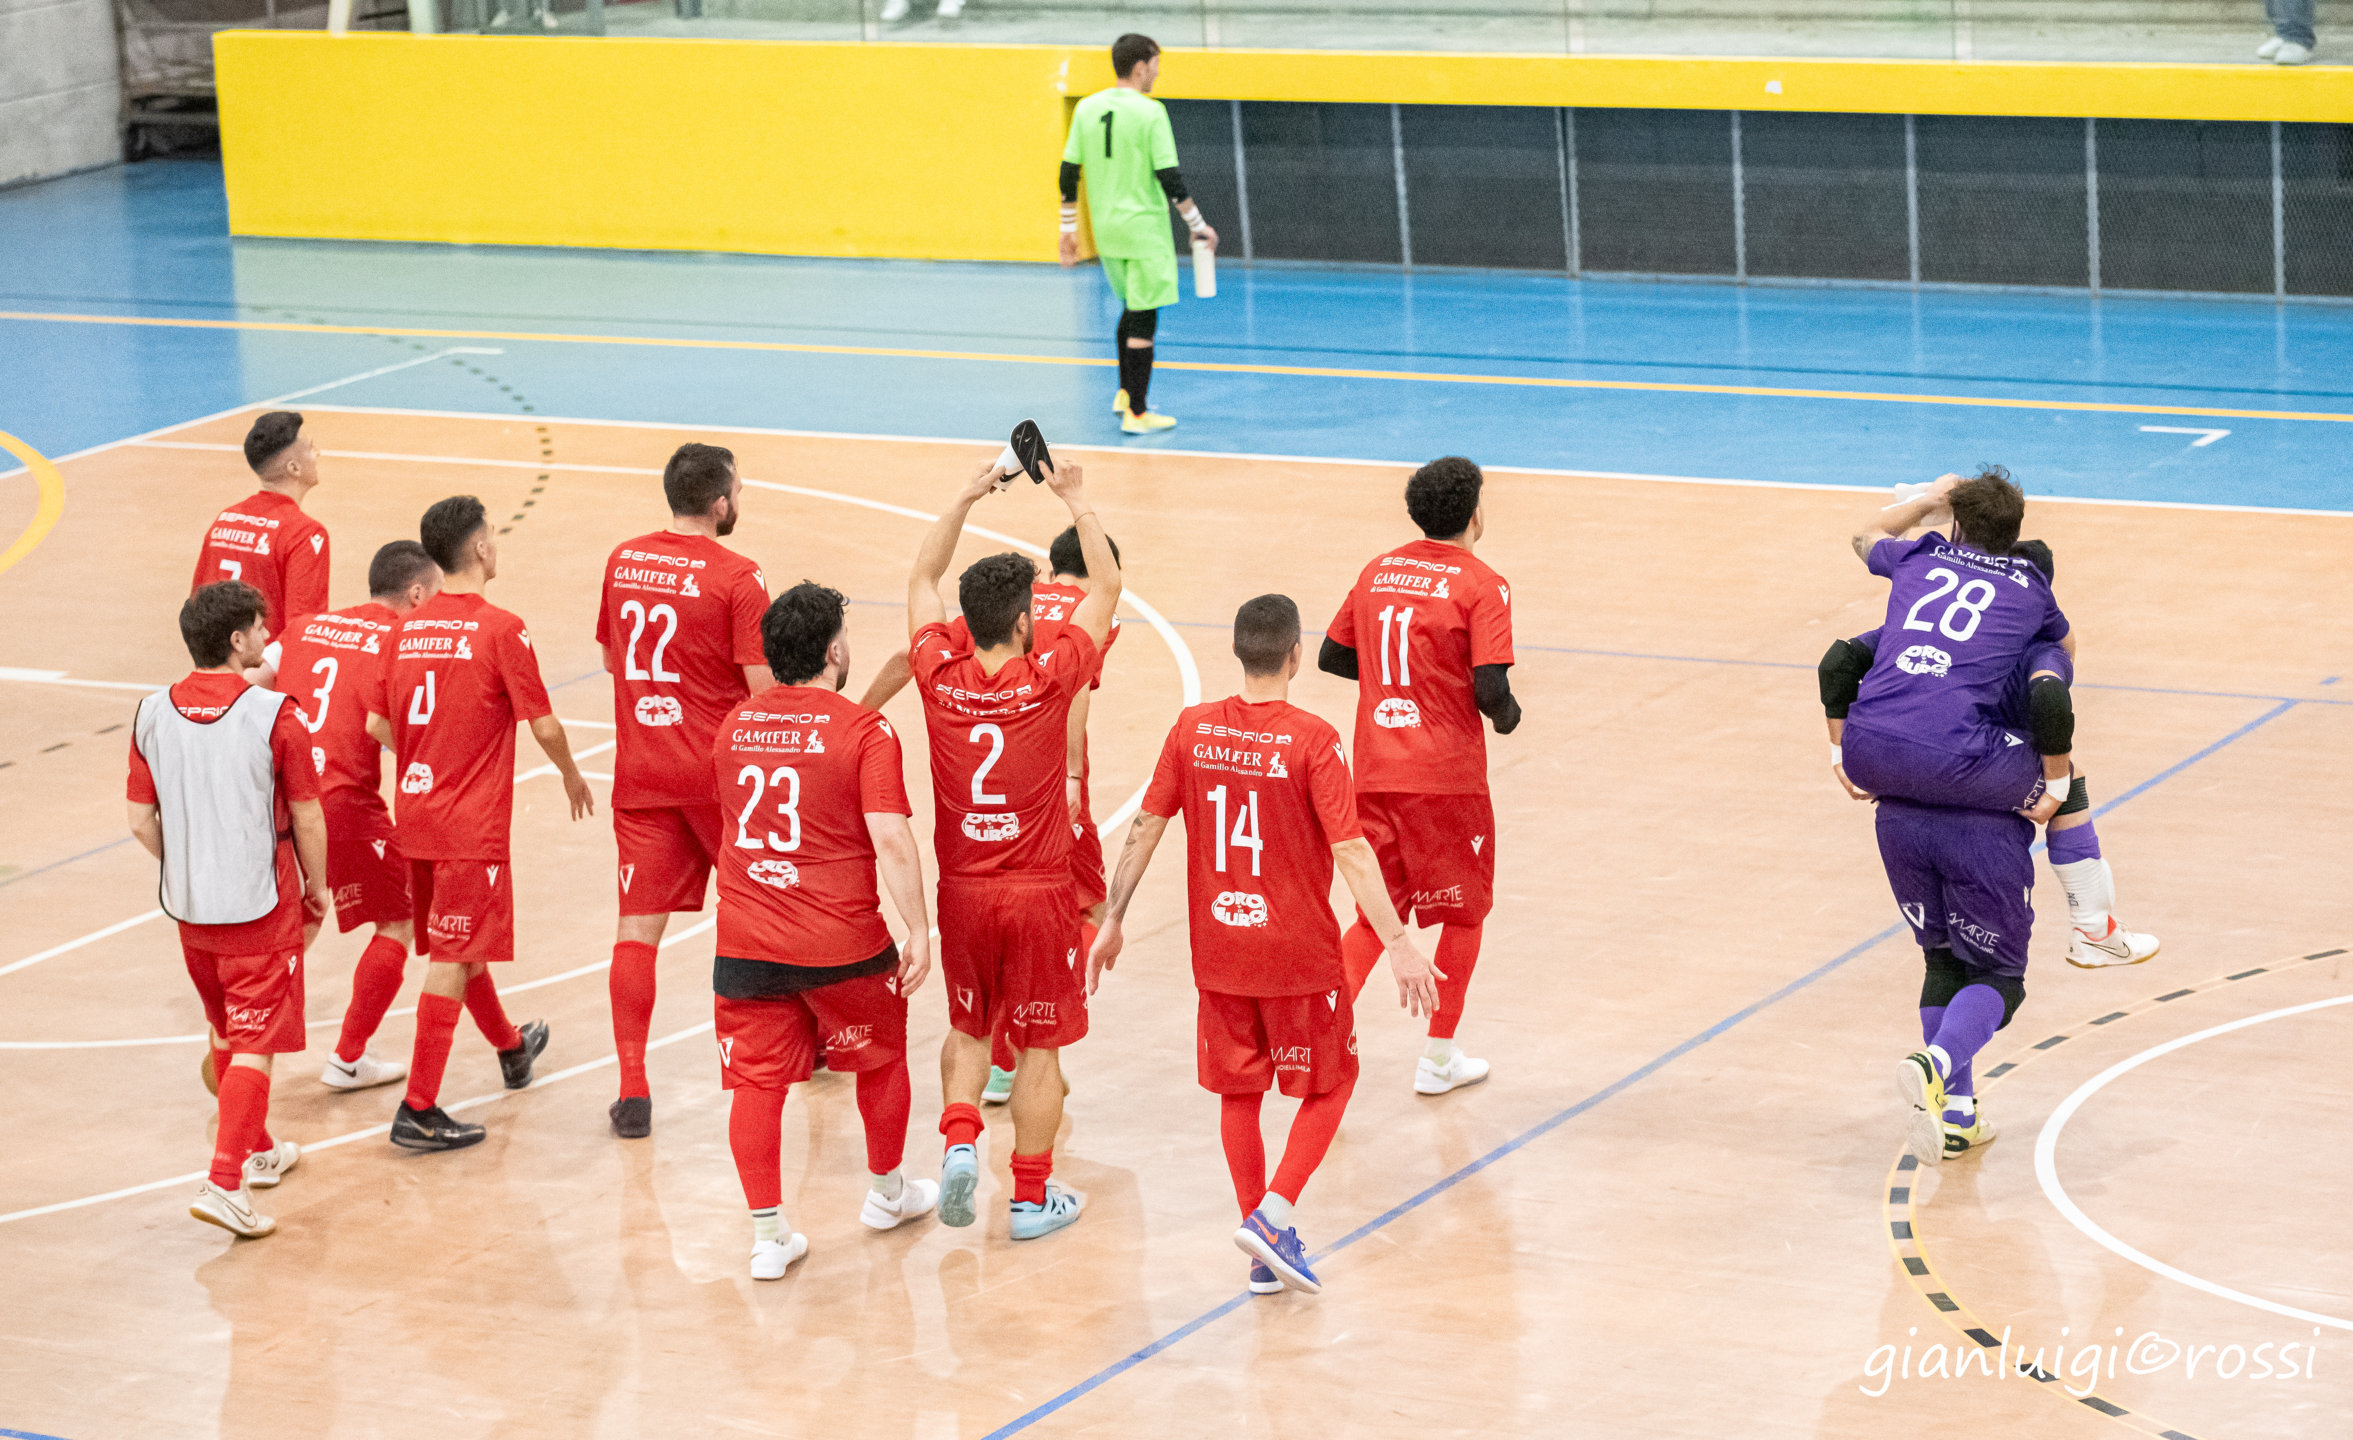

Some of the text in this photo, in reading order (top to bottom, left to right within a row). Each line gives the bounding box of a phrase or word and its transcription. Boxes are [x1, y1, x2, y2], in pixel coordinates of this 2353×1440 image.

[1101, 110, 1114, 159] 1
[211, 527, 256, 545] GAMIFER
[619, 549, 689, 567] SEPRIO
[1379, 556, 1447, 572] SEPRIO
[614, 566, 677, 586] GAMIFER
[1965, 562, 2006, 577] Alessandro
[1373, 572, 1432, 590] GAMIFER
[1903, 567, 1996, 642] 28
[402, 620, 463, 632] SEPRIO
[399, 637, 453, 652] GAMIFER
[620, 599, 681, 683] 22
[1378, 605, 1414, 687] 11
[307, 656, 339, 734] 3
[737, 711, 813, 724] SEPRIO
[732, 729, 801, 745] GAMIFER
[1195, 722, 1274, 744] SEPRIO
[764, 745, 801, 753] Alessandro
[968, 722, 1007, 805] 2
[1193, 760, 1200, 768] di
[1200, 761, 1229, 771] Gamillo
[734, 764, 801, 852] 23
[965, 823, 1018, 842] EURO
[1207, 784, 1264, 877] 14
[334, 882, 363, 902] ARTE
[1217, 891, 1265, 909] ORO
[1410, 884, 1463, 903] MARTE
[1213, 906, 1266, 927] EURO
[1270, 1046, 1312, 1065] MART
